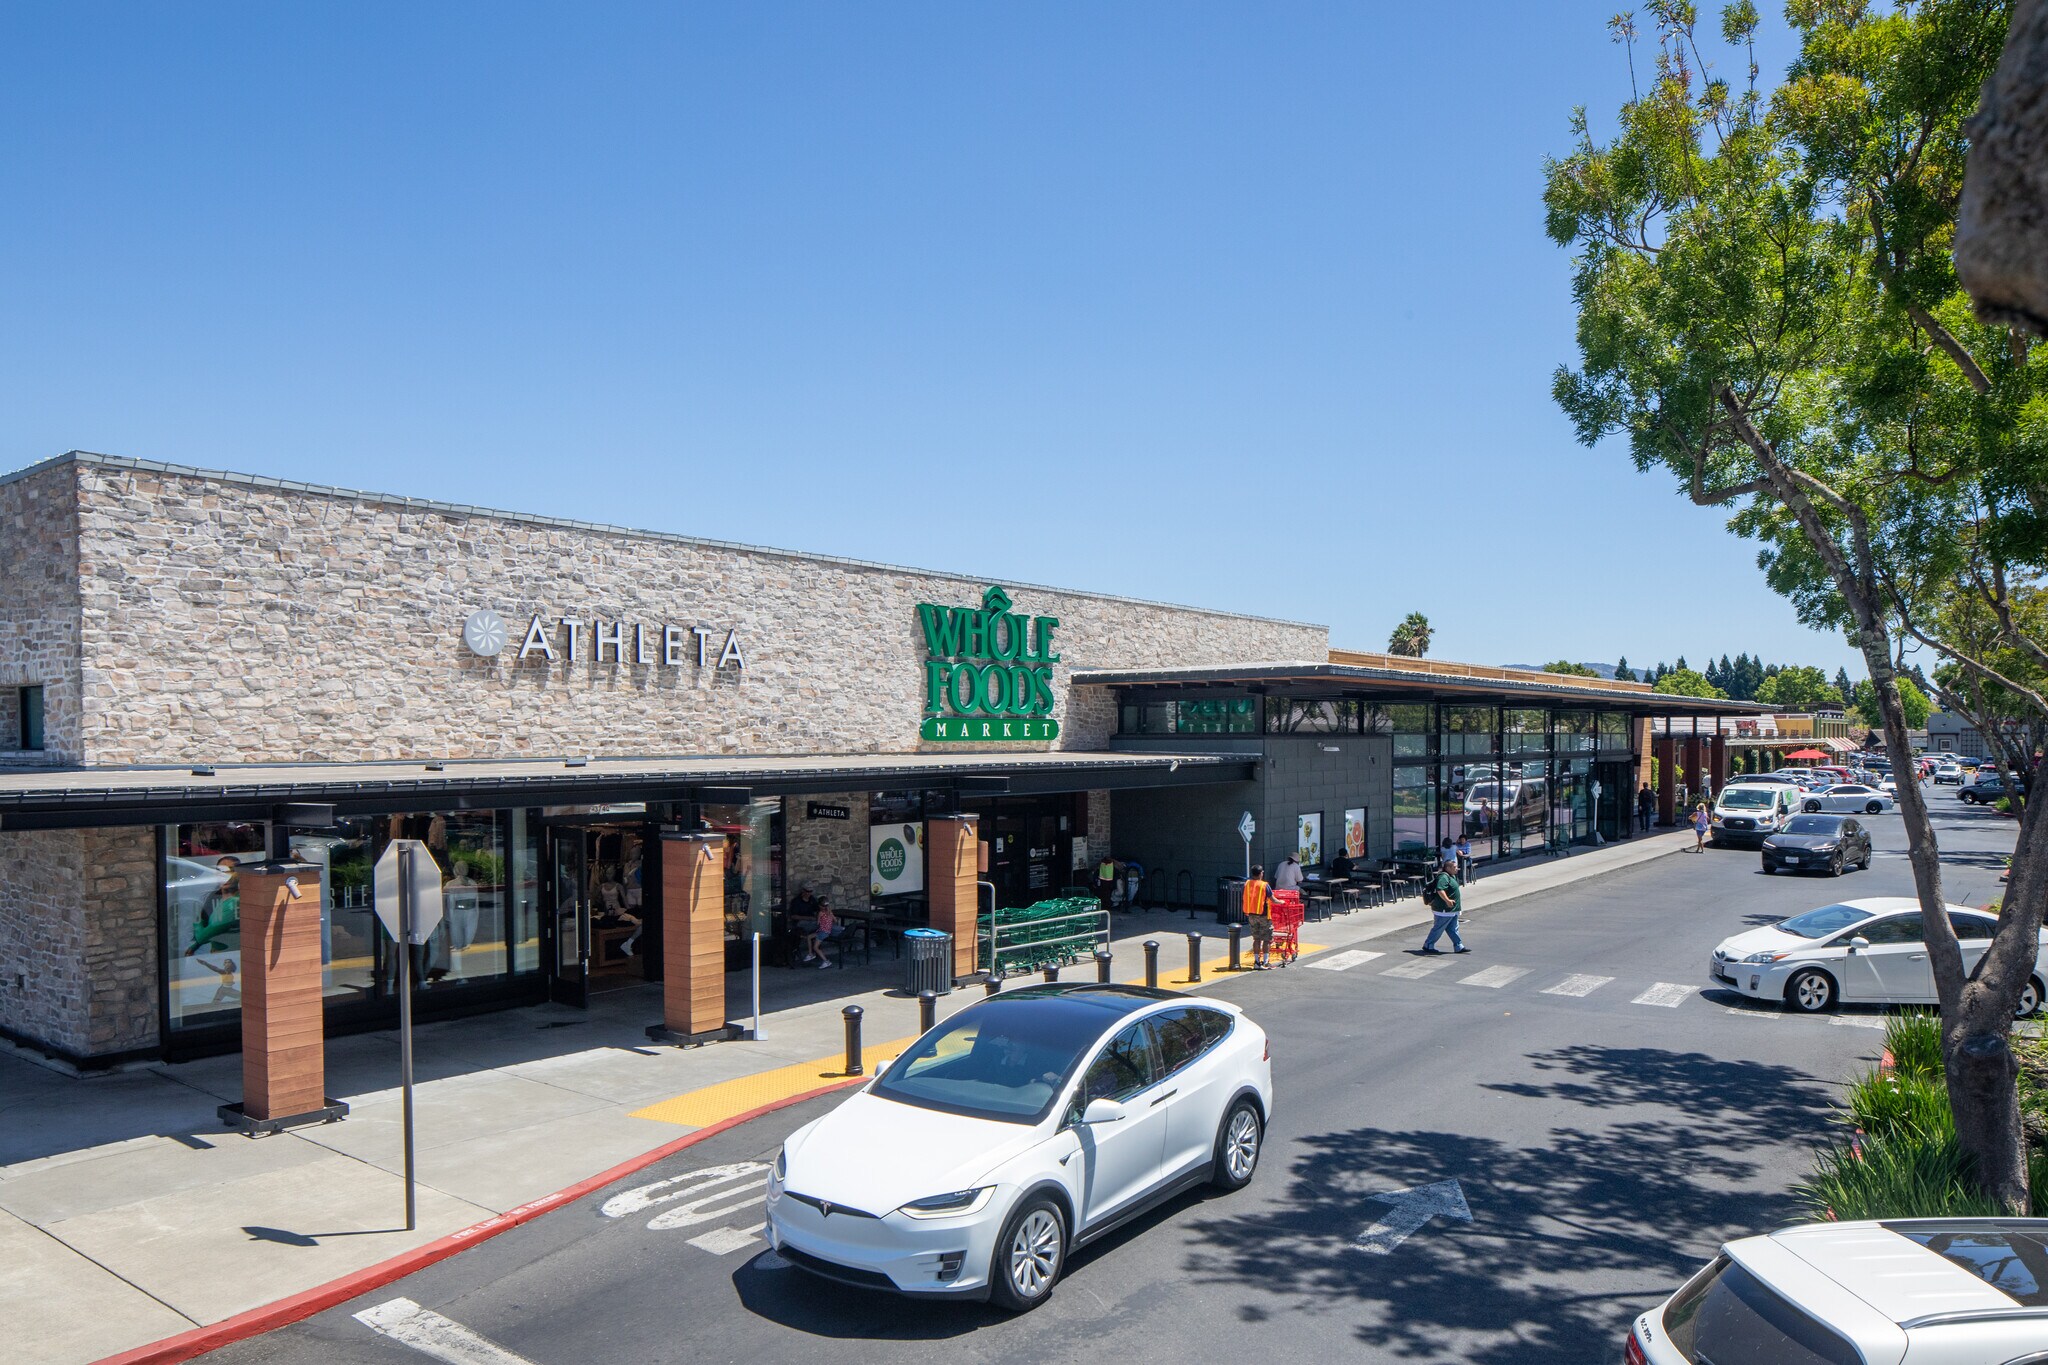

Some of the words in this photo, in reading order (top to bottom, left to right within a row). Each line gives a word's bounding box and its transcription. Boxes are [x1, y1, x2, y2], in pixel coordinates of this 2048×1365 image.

[916, 586, 1060, 662] WHOLE
[519, 613, 746, 669] ATHLETA
[925, 661, 1054, 715] FOODS
[936, 722, 1050, 737] MARKET
[818, 807, 846, 817] ATHLETA
[880, 847, 903, 859] WHOLE
[881, 858, 902, 868] FOODS
[329, 884, 368, 910] SHE
